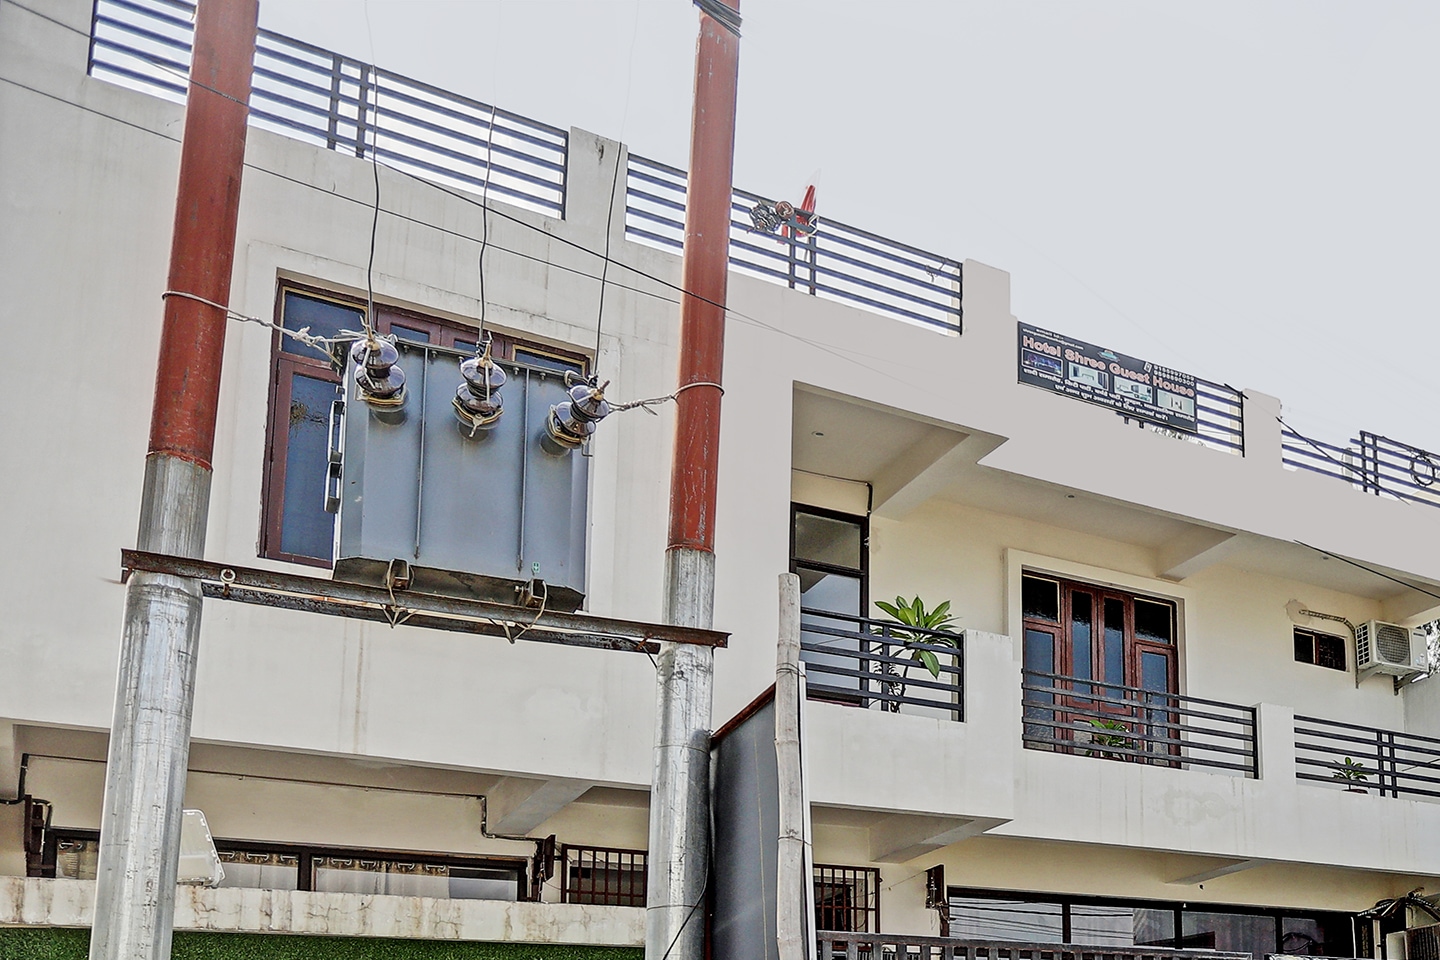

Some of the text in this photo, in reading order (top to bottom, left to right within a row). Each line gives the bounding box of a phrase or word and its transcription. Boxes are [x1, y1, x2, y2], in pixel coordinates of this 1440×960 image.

[1023, 335, 1195, 397] Hotel Shree Guest House
